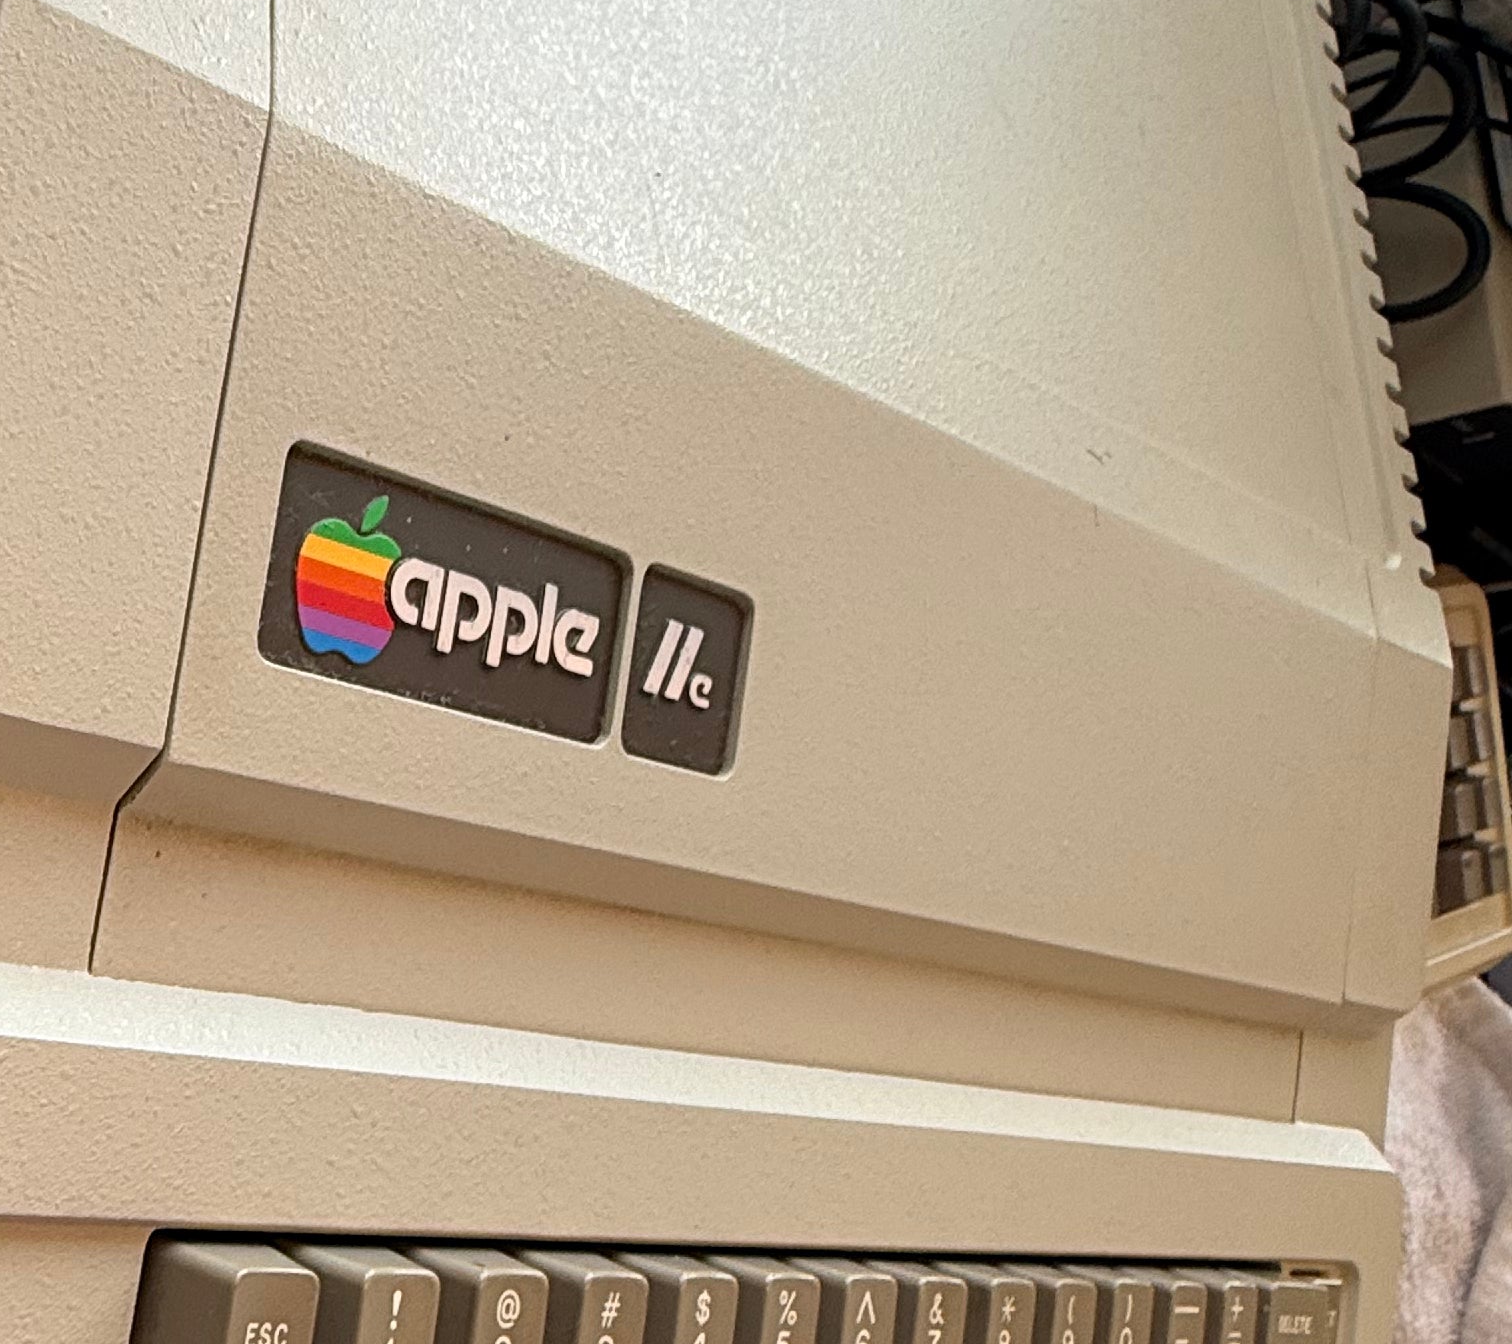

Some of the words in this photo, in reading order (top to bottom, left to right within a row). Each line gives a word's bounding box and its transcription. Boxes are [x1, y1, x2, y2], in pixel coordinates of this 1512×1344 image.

[390, 557, 600, 677] apple
[389, 1290, 402, 1331] !
[496, 1289, 521, 1329] @
[601, 1292, 621, 1328] #
[695, 1289, 711, 1326] $
[779, 1289, 798, 1326] %
[928, 1292, 944, 1325] &
[1067, 1295, 1076, 1324] (
[1125, 1293, 1133, 1323] )
[1231, 1296, 1244, 1321] +
